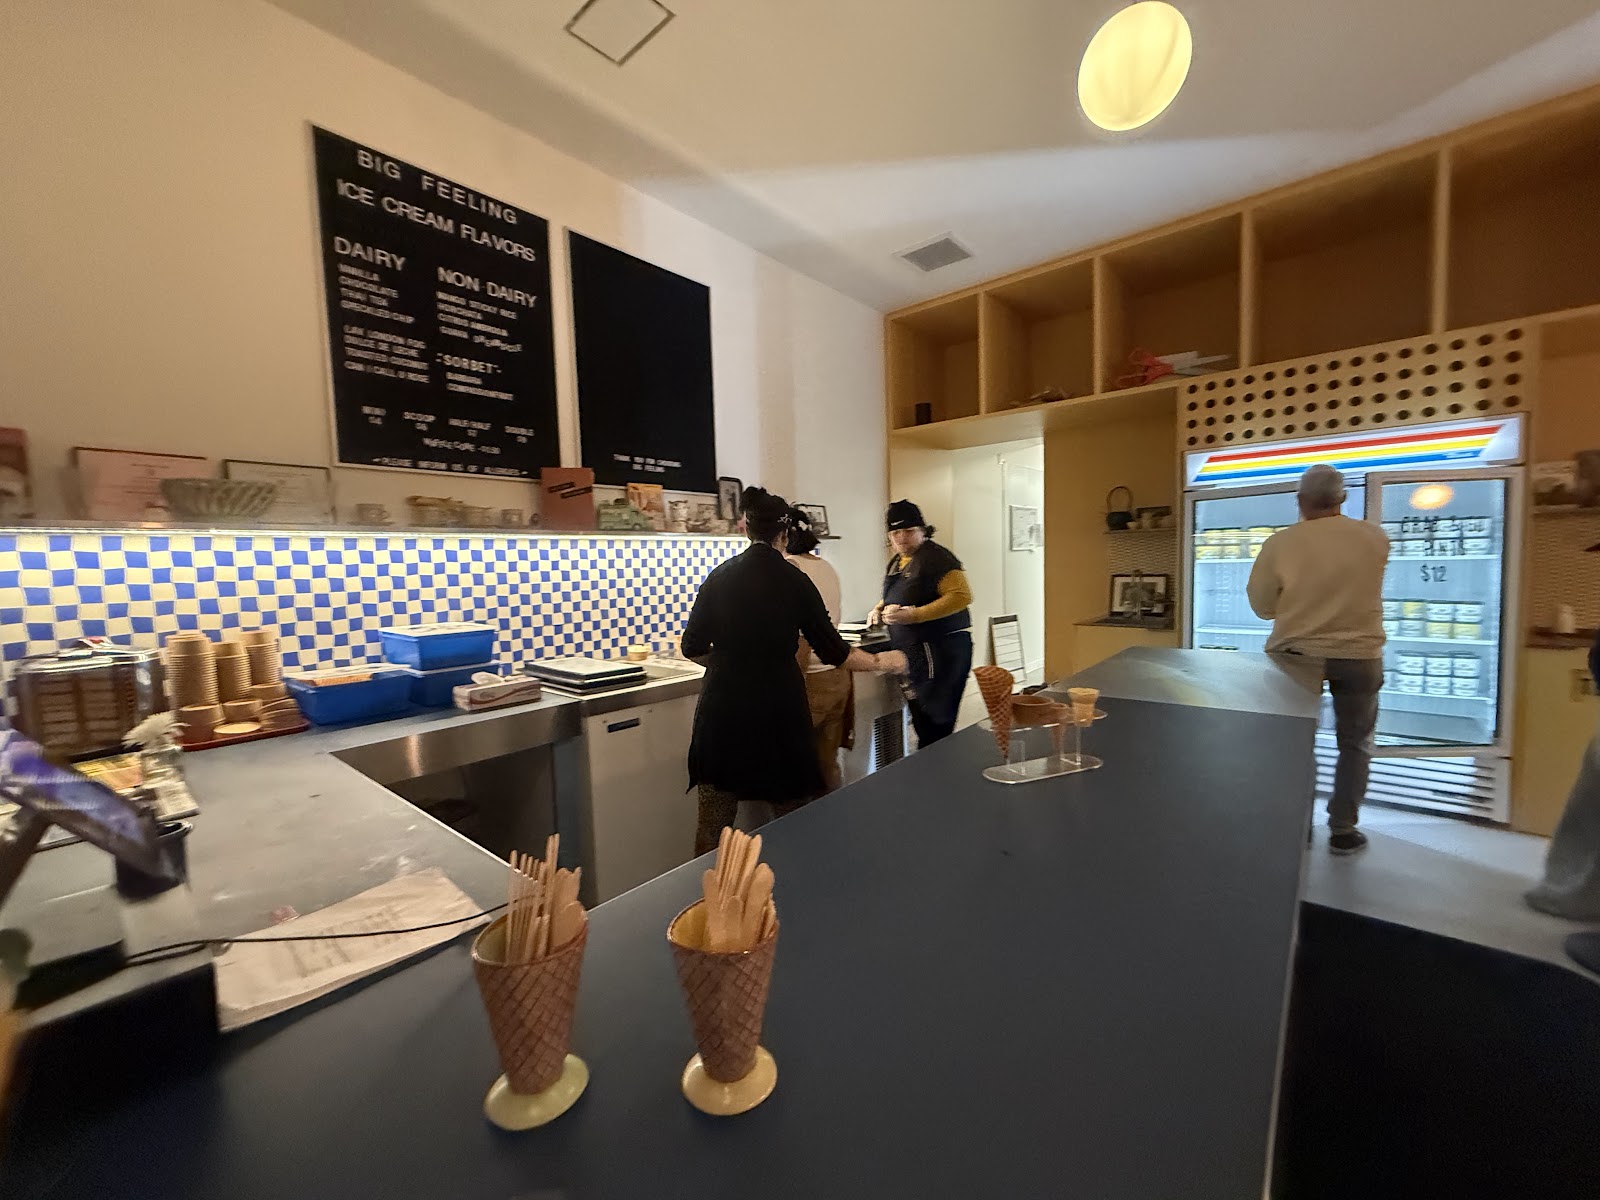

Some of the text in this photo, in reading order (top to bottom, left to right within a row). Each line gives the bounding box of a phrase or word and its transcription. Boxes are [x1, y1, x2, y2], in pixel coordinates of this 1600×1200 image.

[357, 149, 518, 224] BIG FEELING
[336, 178, 536, 262] ICE CREAM FLAVORS
[333, 236, 406, 271] DAIRY
[338, 275, 399, 298] CHOCOLATE
[437, 266, 537, 308] NON DAIRY
[499, 308, 518, 320] RICE
[443, 354, 494, 374] SORBET
[403, 411, 436, 423] SCOOP
[1419, 562, 1447, 583] $12
